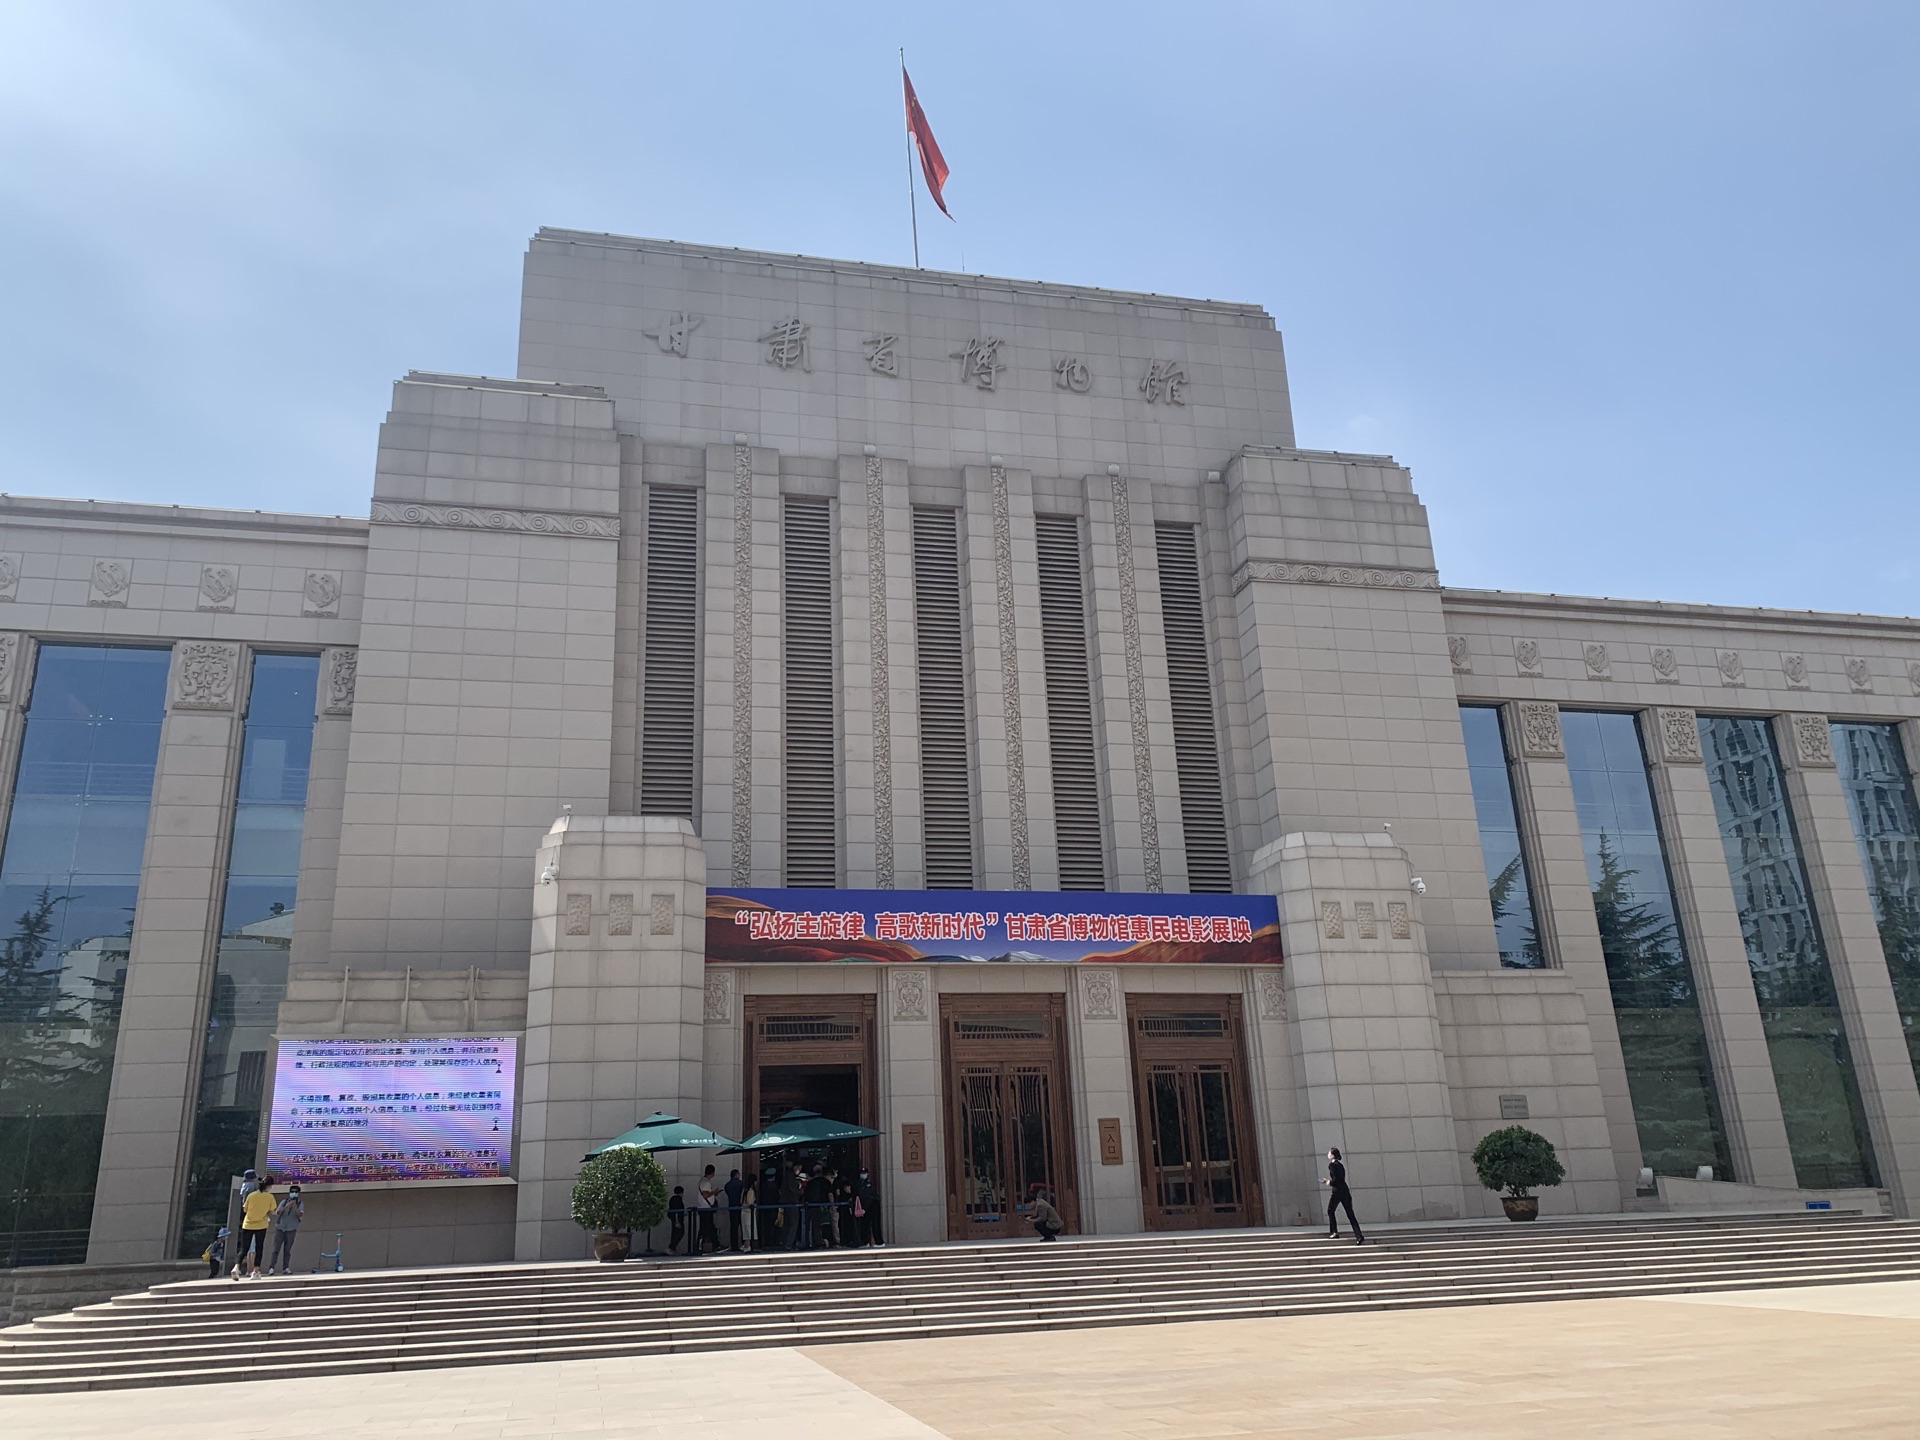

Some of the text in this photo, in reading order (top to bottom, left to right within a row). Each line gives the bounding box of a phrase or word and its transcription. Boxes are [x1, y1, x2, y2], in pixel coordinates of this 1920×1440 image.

[735, 910, 1252, 943] “弘扬主旋律 高歌新时代” 甘肃省博物馆惠民电影展映
